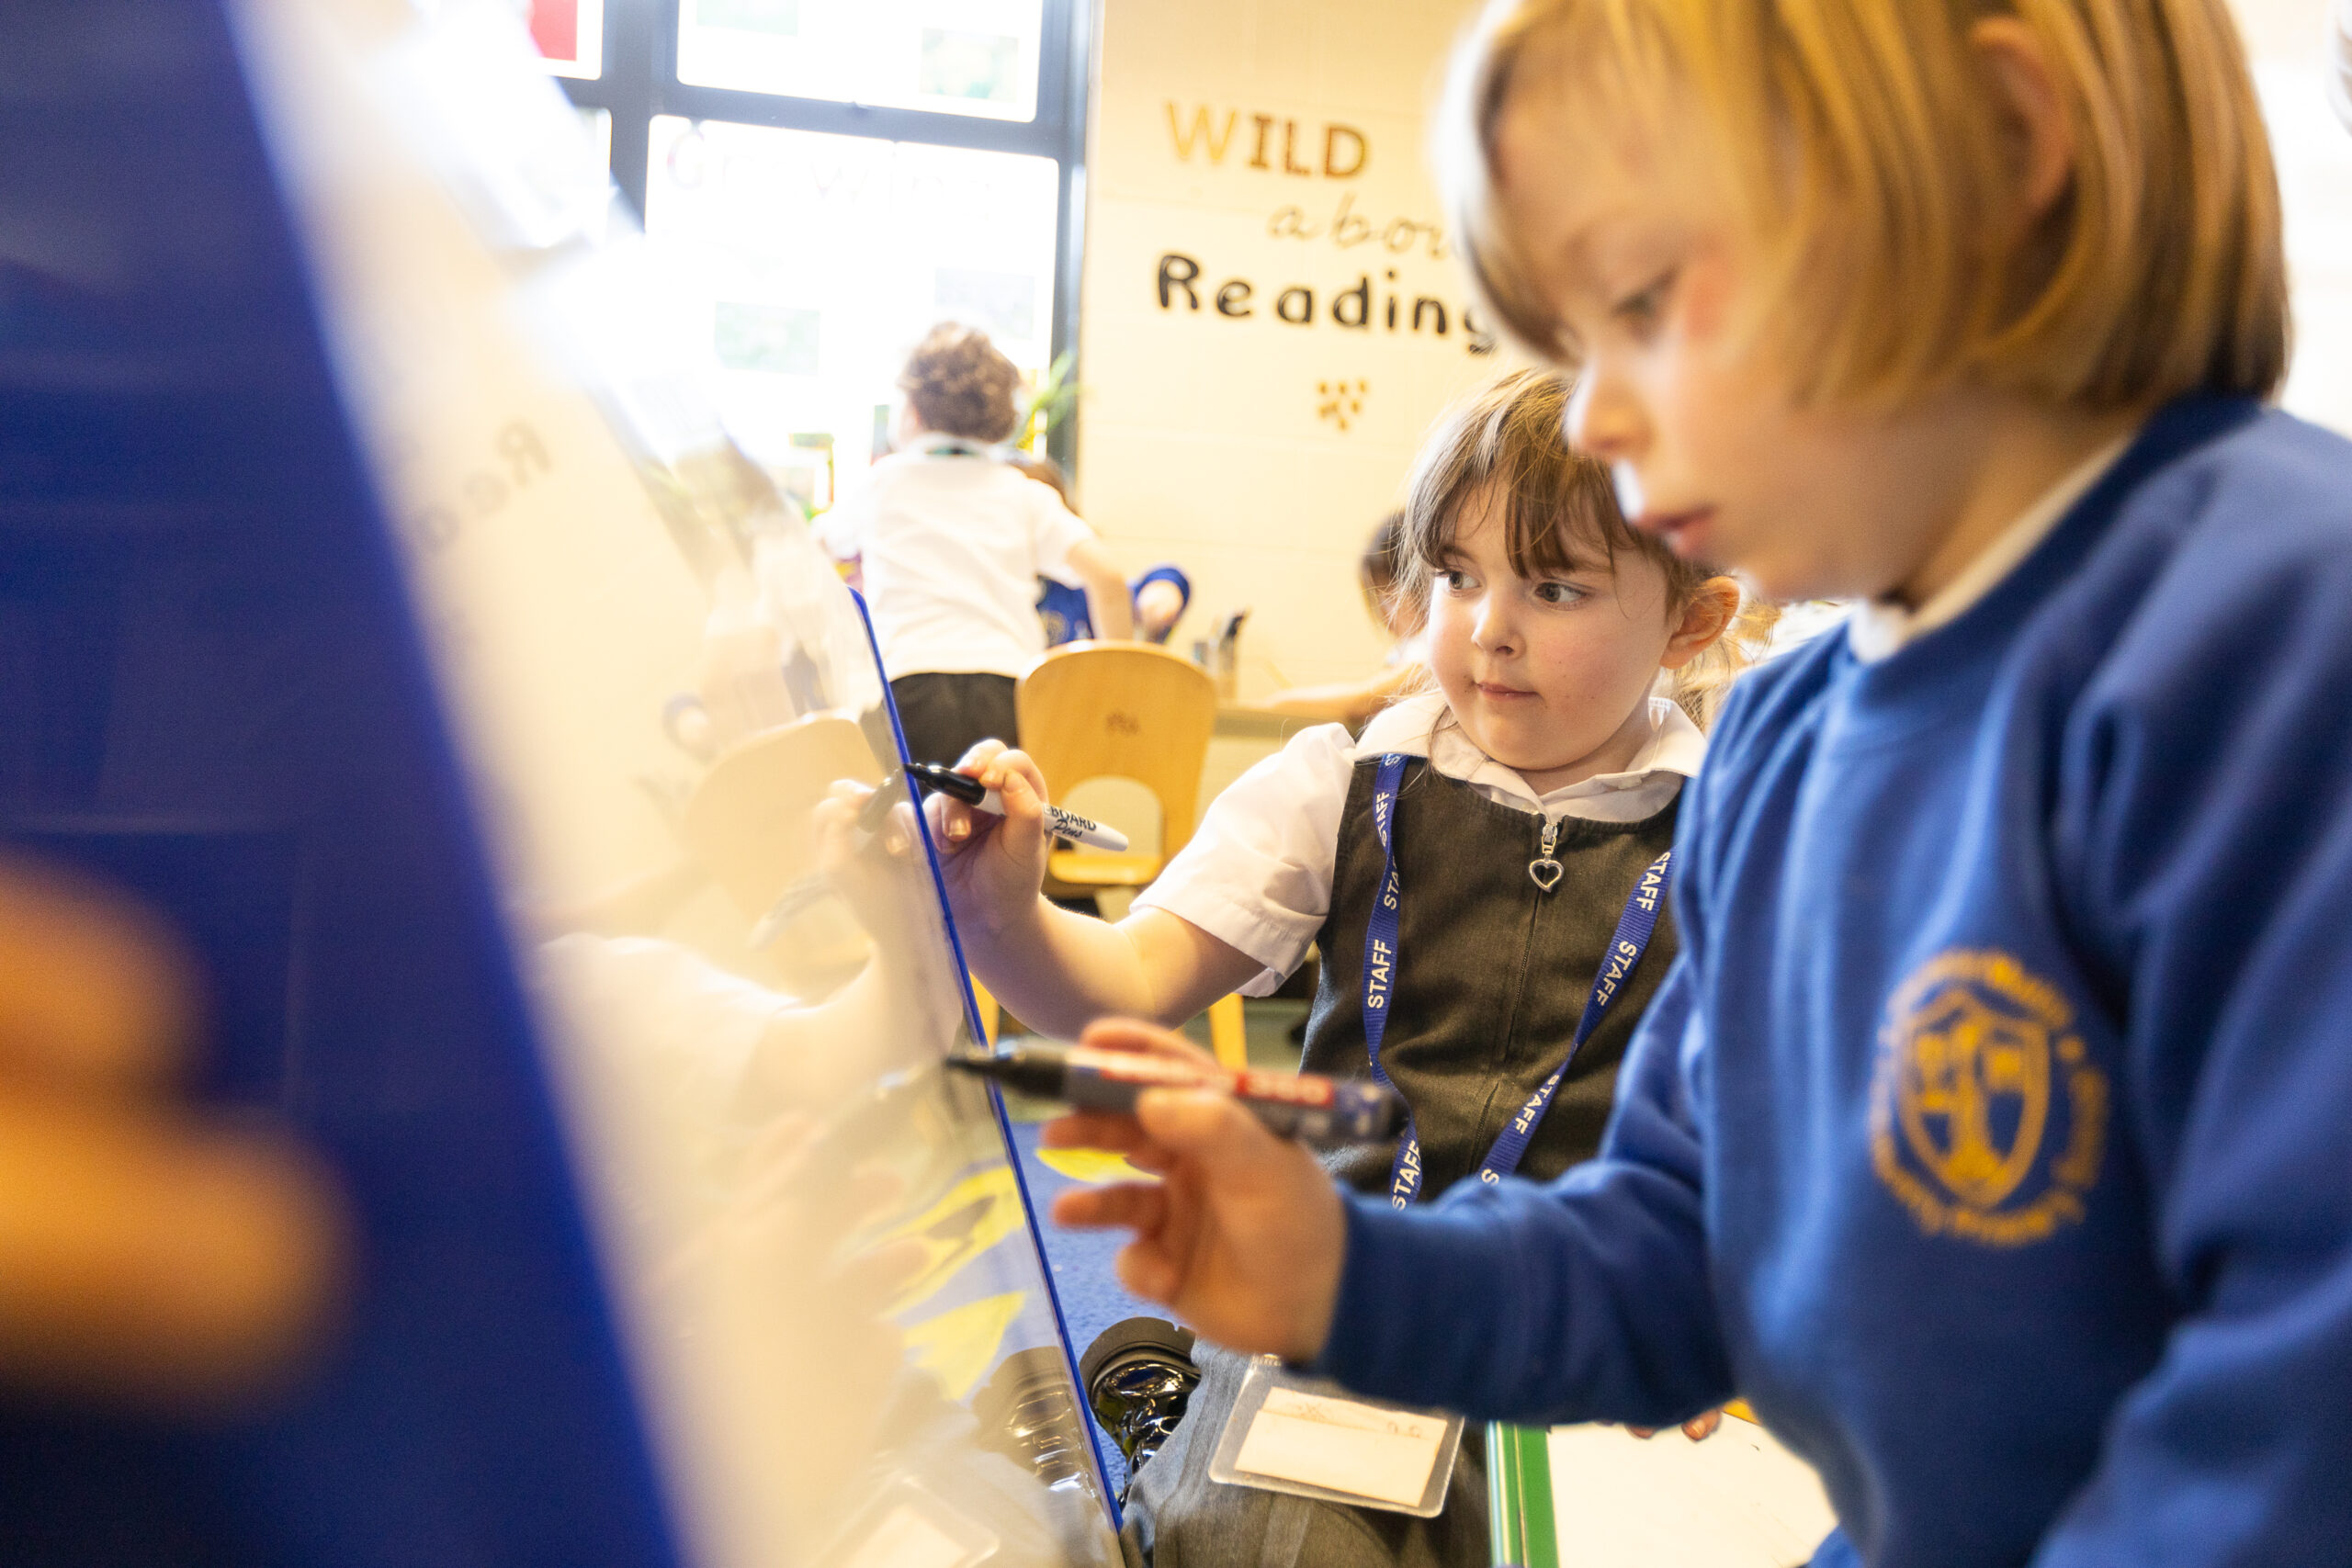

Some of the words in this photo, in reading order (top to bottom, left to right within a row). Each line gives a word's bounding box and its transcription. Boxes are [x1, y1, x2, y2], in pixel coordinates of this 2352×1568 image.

[1165, 101, 1370, 178] WILD
[1375, 791, 1390, 847] STAFF
[1384, 855, 1400, 910] STA
[1636, 852, 1671, 911] STAFF
[1367, 939, 1393, 1009] STAFF
[1597, 940, 1637, 1007] STAFF
[1514, 1074, 1560, 1134] STAFF
[1392, 1140, 1422, 1212] STAFF
